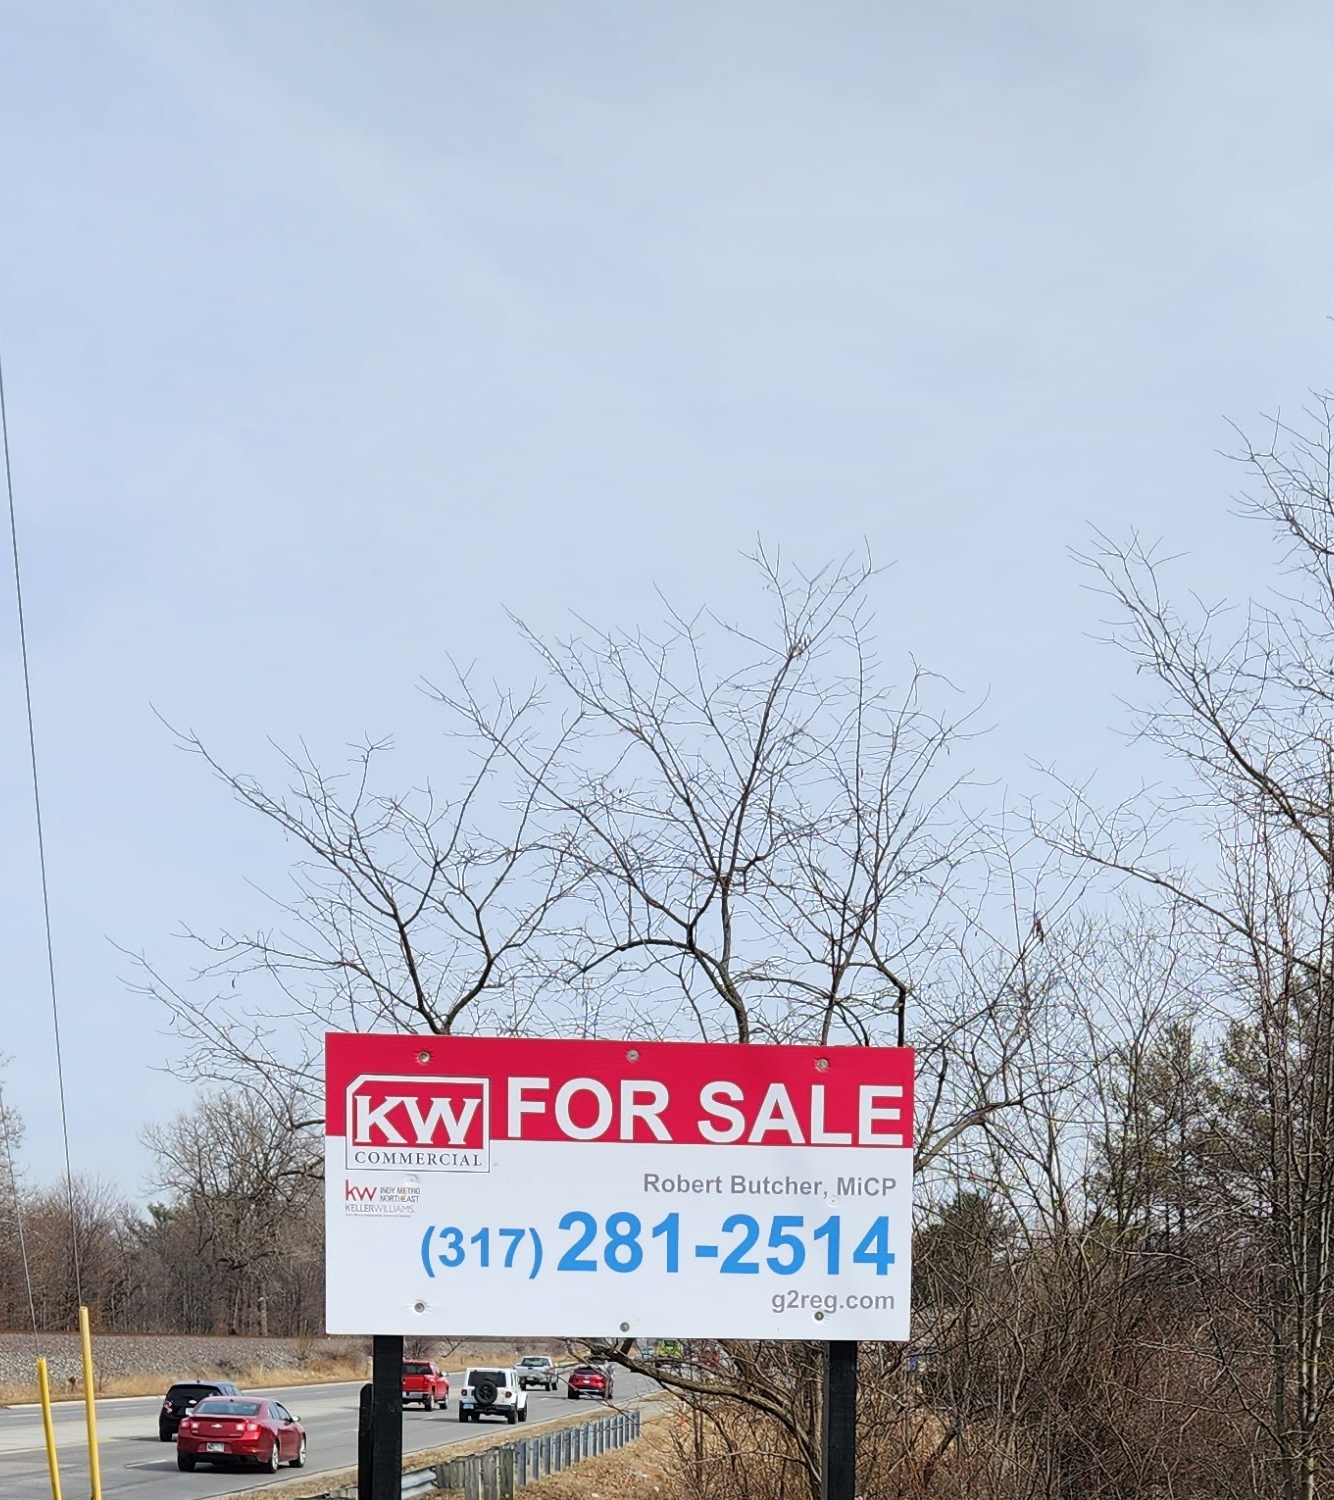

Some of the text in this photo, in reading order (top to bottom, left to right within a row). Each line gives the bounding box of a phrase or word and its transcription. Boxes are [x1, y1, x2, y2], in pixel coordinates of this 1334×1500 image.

[353, 1094, 482, 1145] KW
[507, 1076, 904, 1147] FOR SALE
[354, 1150, 483, 1167] COMMERCIAL
[345, 1179, 377, 1202] kw
[397, 1187, 421, 1195] METRO
[643, 1173, 897, 1199] Robert Butcher, MiCP
[380, 1195, 420, 1203] NORTHEAST
[420, 1210, 896, 1280] (317) 281-2514
[771, 1289, 896, 1313] g2reg.com
